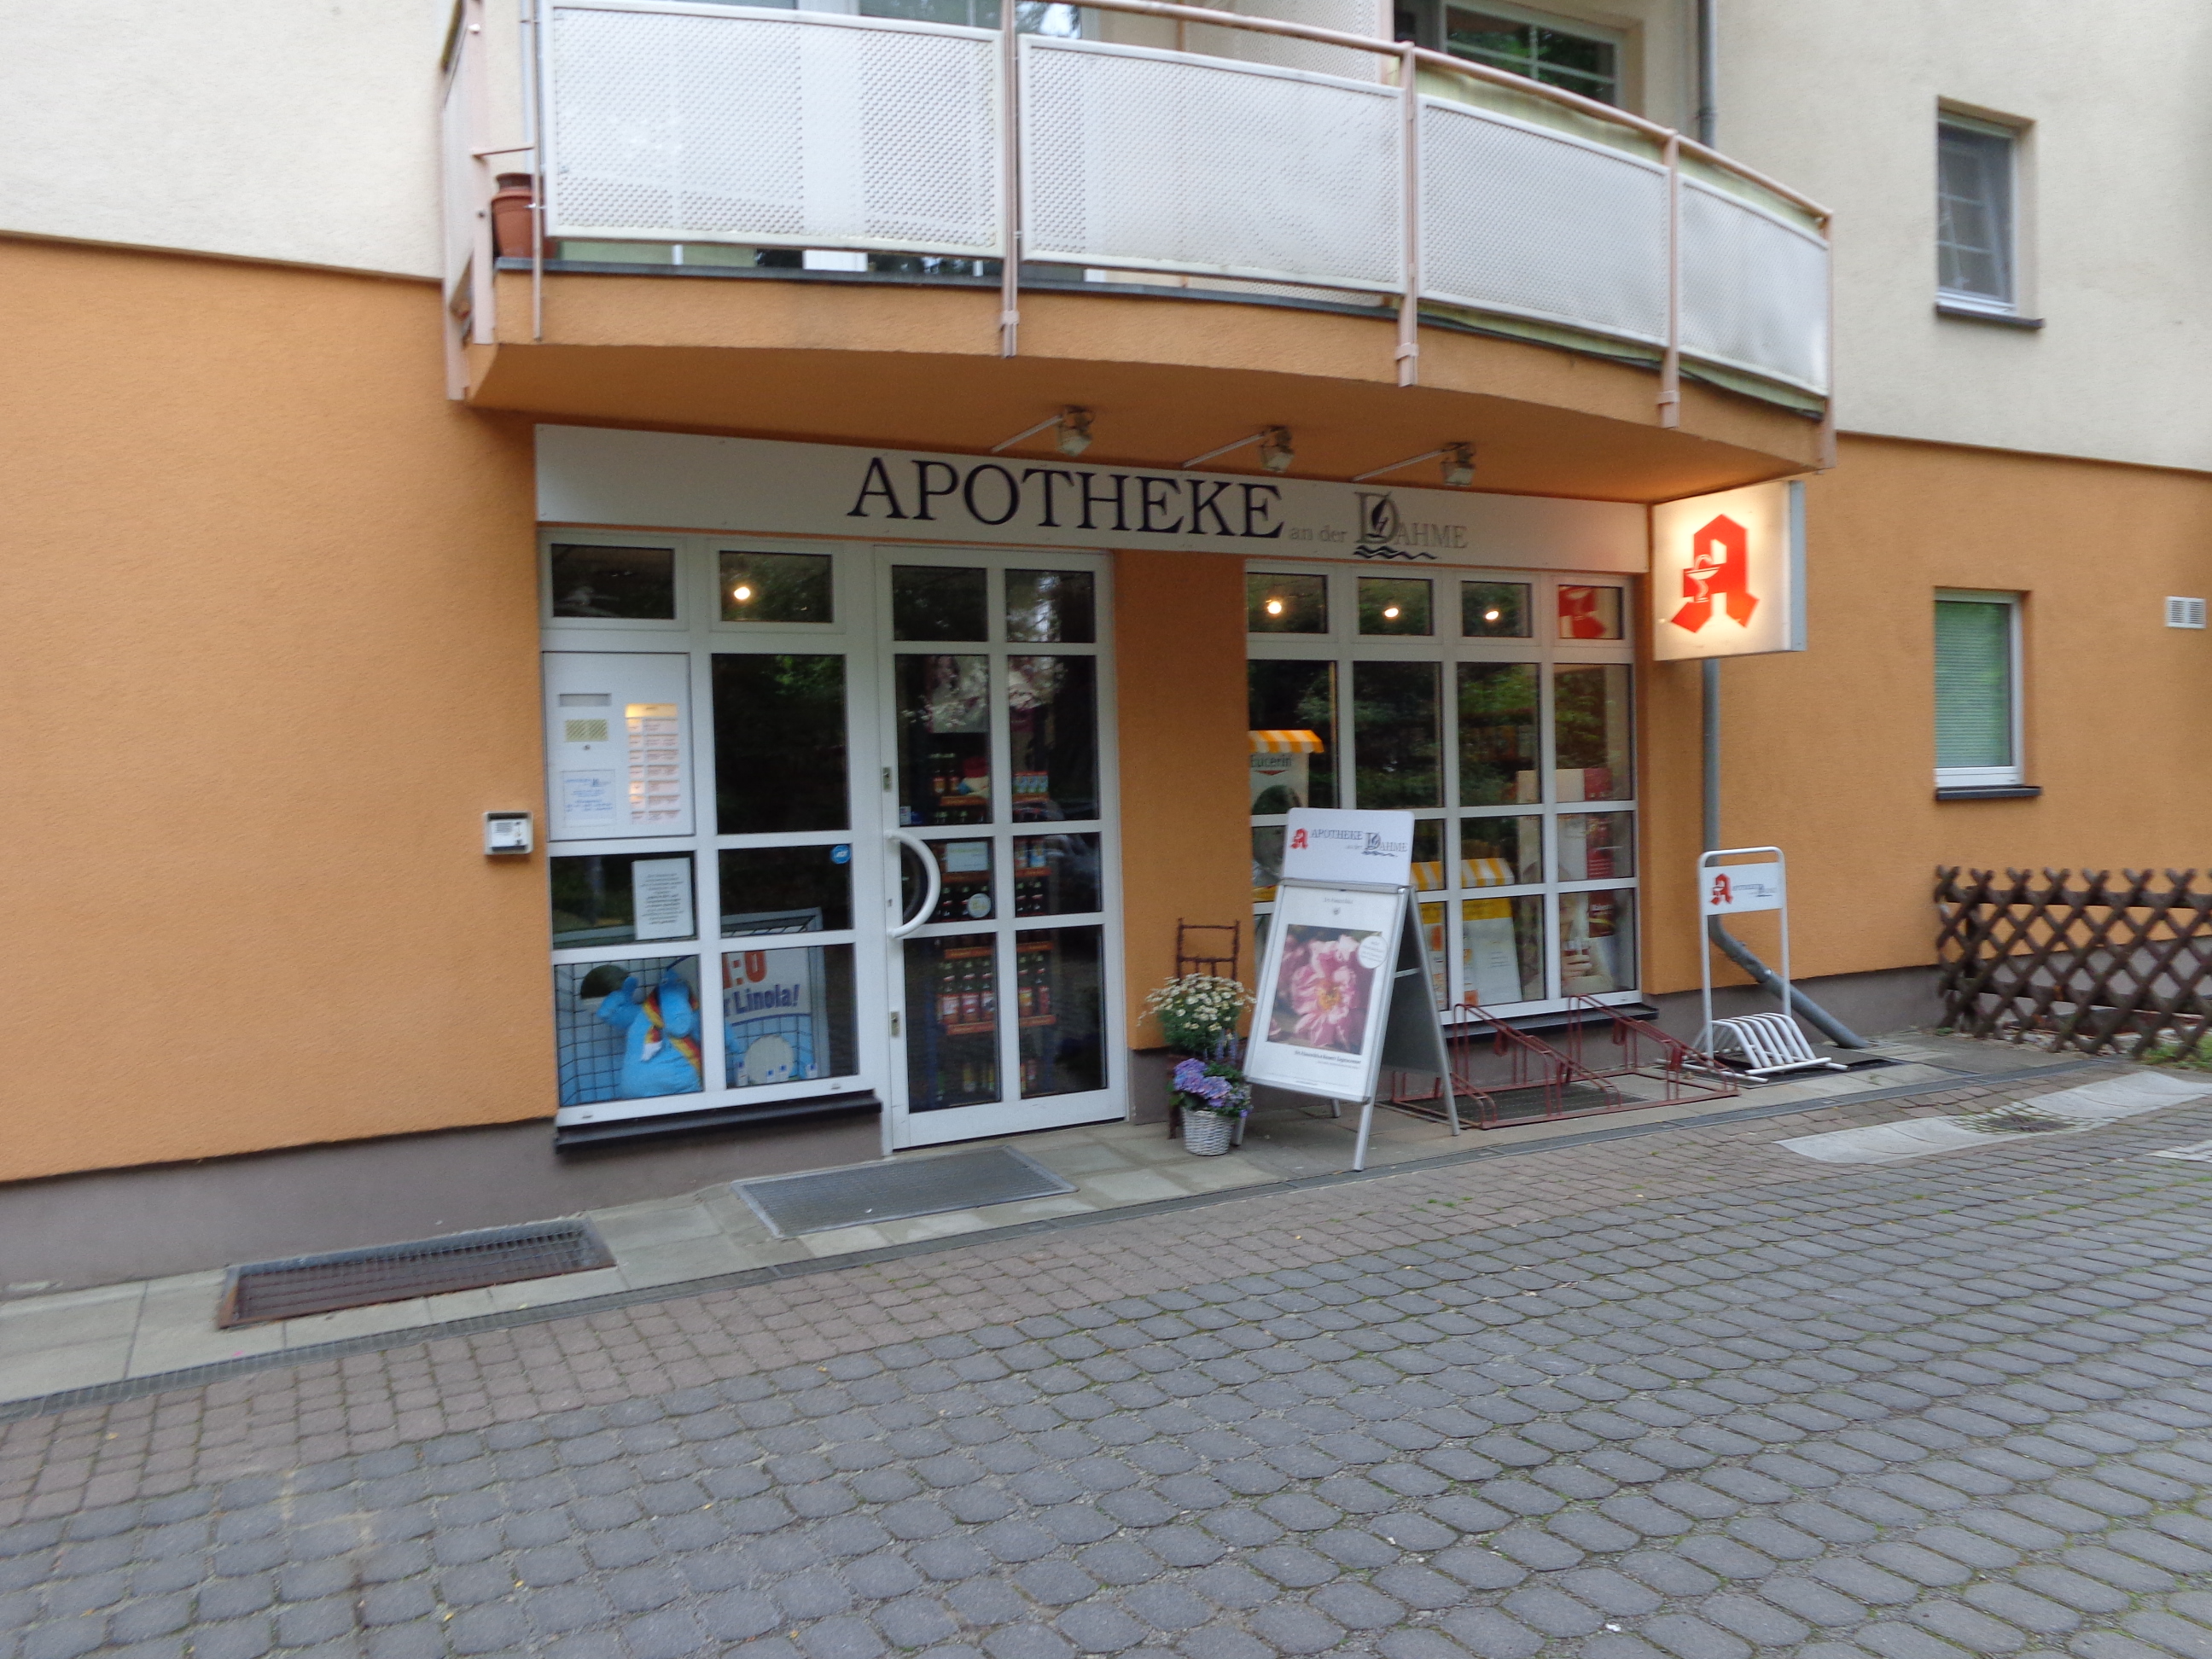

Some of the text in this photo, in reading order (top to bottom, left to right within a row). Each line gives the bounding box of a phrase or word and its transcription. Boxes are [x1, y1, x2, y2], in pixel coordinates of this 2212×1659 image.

[847, 456, 1468, 549] APOTHEKE an der DAHME
[1311, 829, 1365, 841] APOTHEKE
[733, 983, 800, 1014] Linola!
